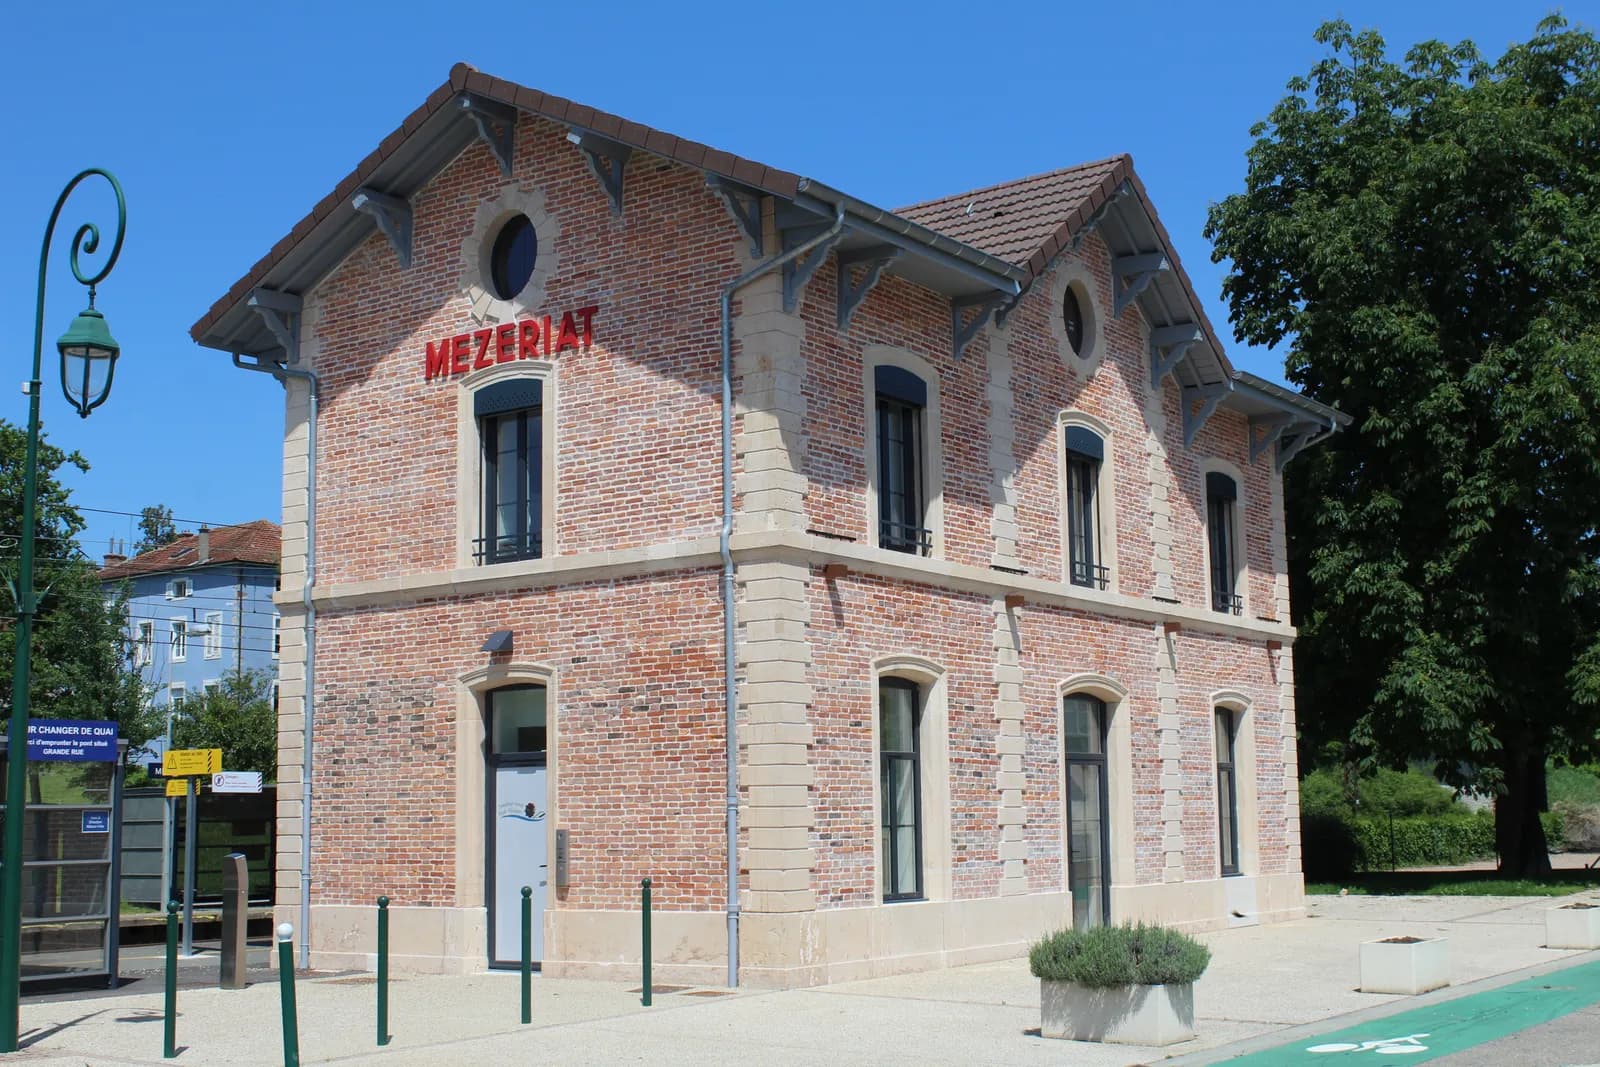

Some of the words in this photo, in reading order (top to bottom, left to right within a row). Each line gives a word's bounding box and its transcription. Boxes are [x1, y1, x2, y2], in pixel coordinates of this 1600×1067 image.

[425, 306, 599, 380] MEZERIAT
[38, 726, 79, 735] CHANGER
[81, 727, 92, 735] DE
[93, 727, 114, 736] QUAI
[79, 740, 93, 748] pont
[71, 748, 84, 756] RUE
